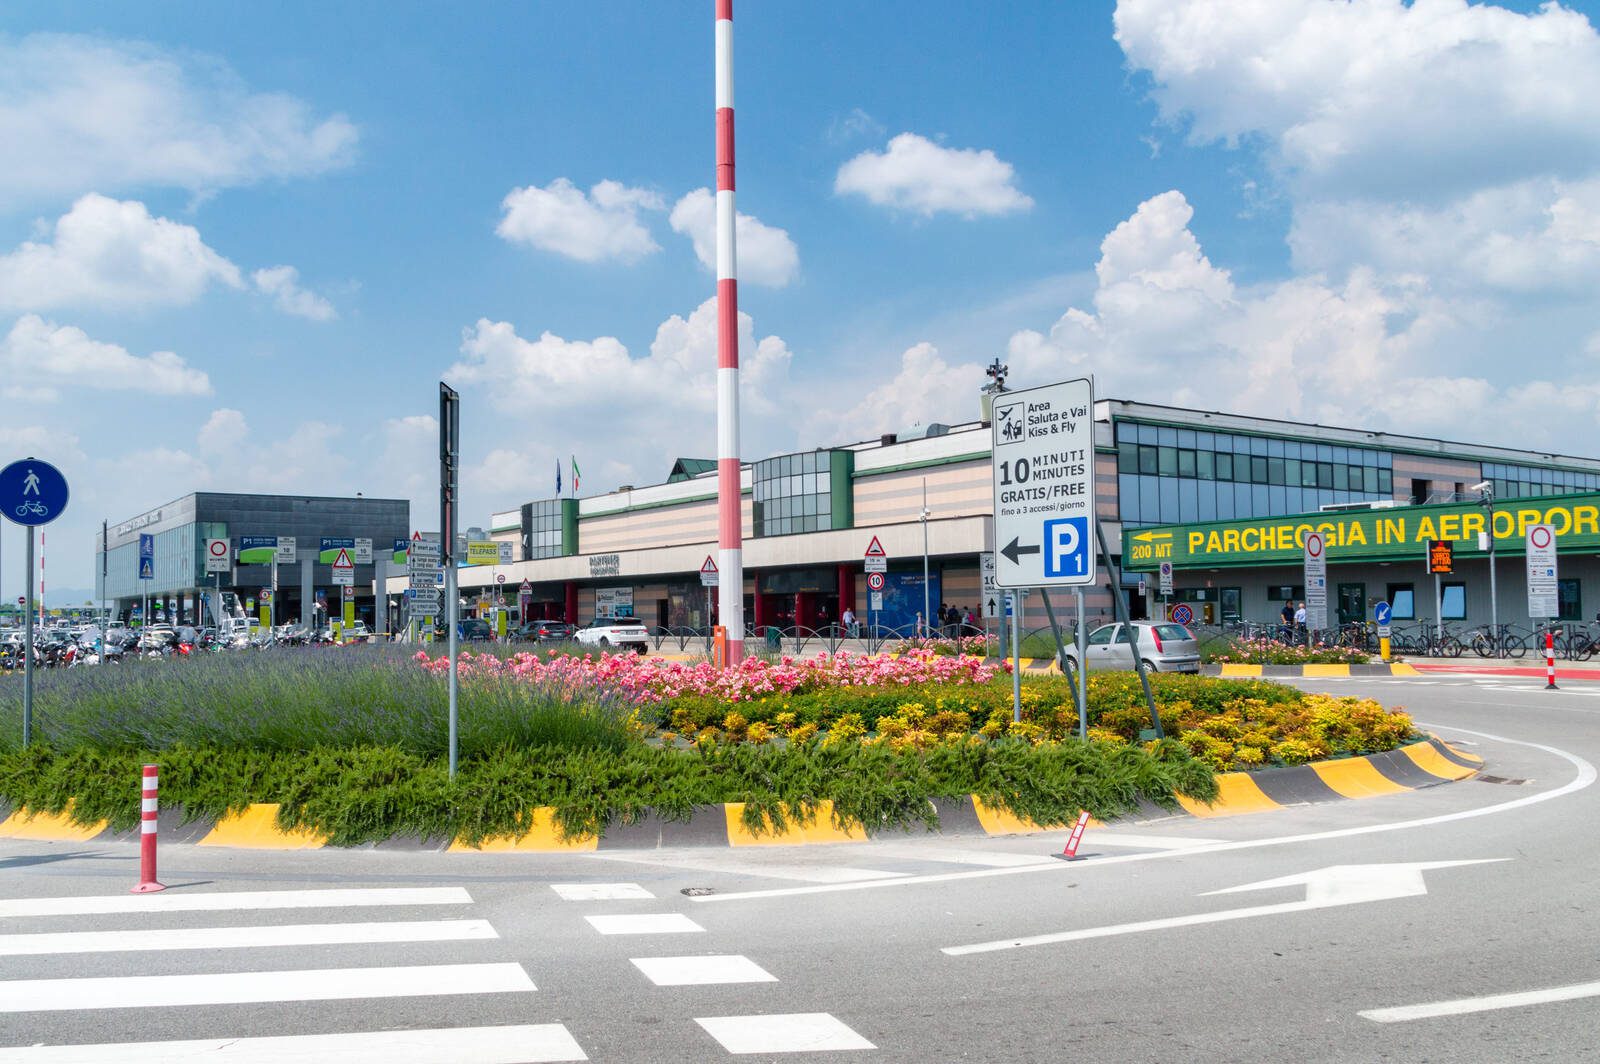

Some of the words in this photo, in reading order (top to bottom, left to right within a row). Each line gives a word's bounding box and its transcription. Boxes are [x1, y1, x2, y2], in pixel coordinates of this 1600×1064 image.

[1028, 402, 1050, 413] Area
[1028, 412, 1059, 426] Saluta
[1061, 411, 1068, 420] e
[1070, 405, 1087, 418] Vai
[1028, 426, 1048, 438] Kiss
[1050, 423, 1059, 434] &
[1061, 421, 1076, 433] Fly
[1000, 458, 1030, 486] 10
[1032, 449, 1085, 467] MINUTI
[1032, 464, 1085, 481] MINUTES
[1001, 507, 1015, 516] fino
[1023, 506, 1028, 514] 3
[1376, 517, 1406, 545] IN
[1132, 545, 1151, 559] 200
[1155, 543, 1173, 558] MT
[872, 577, 881, 586] 10
